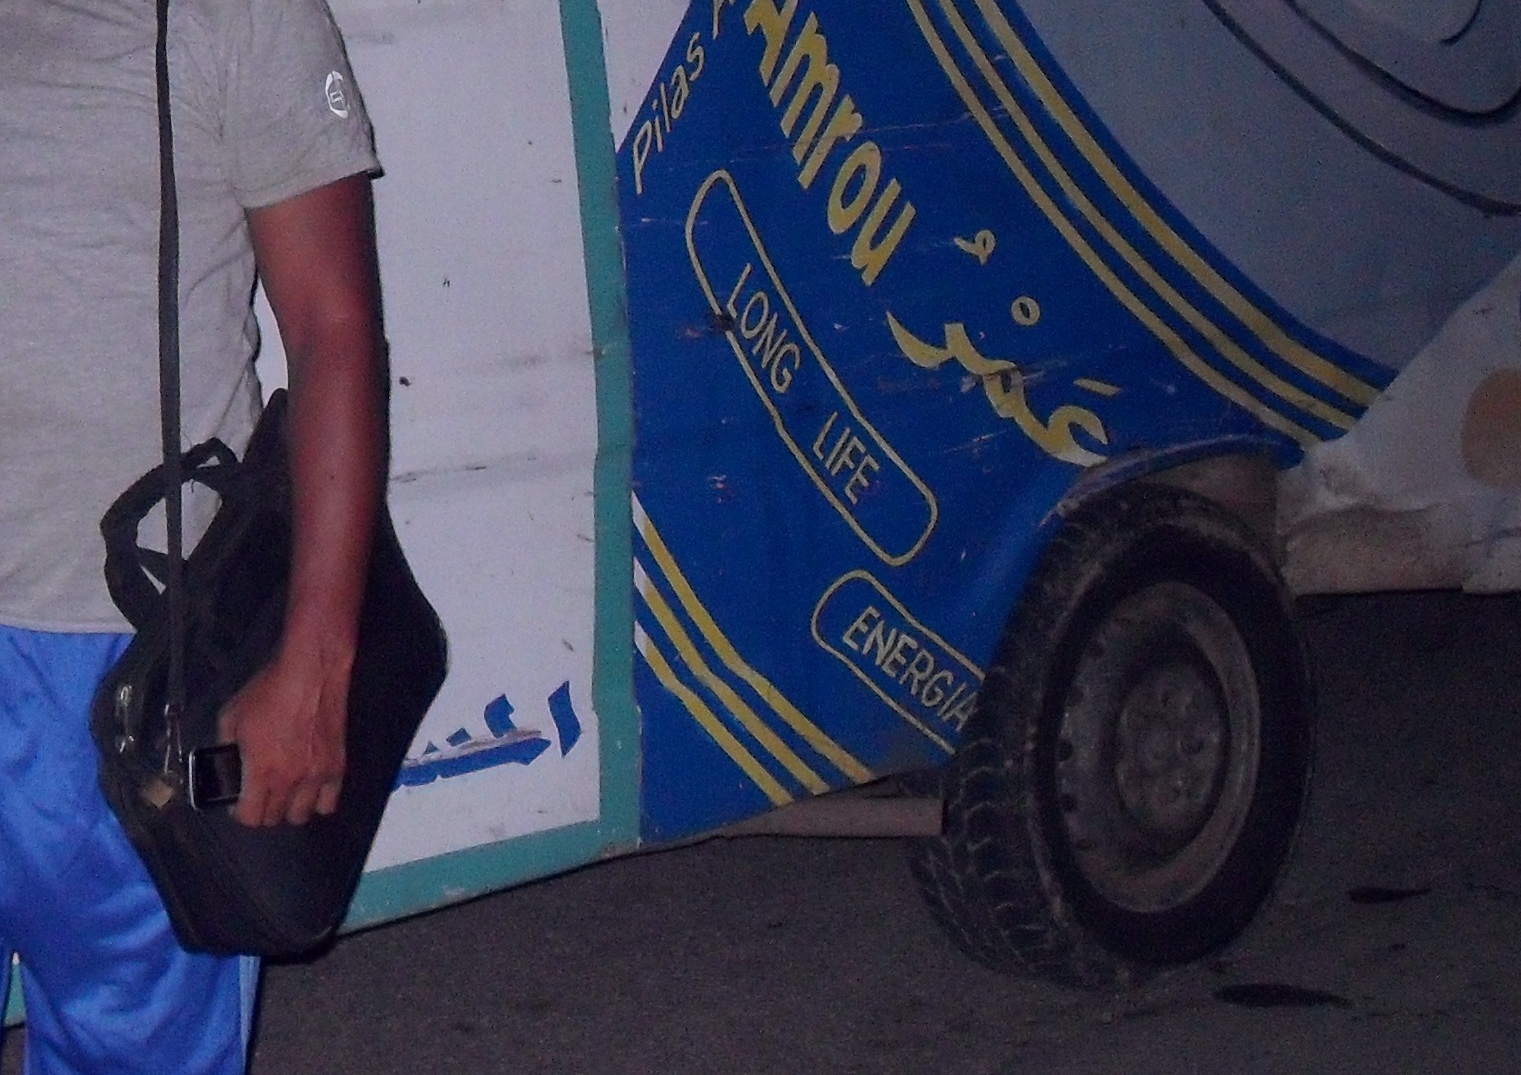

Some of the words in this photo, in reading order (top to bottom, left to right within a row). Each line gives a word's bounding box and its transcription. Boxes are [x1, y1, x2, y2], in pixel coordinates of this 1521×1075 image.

[630, 43, 706, 195] Pilas
[726, 263, 802, 396] LONG
[813, 411, 881, 508] LIFE
[841, 606, 980, 734] ENERGIA
